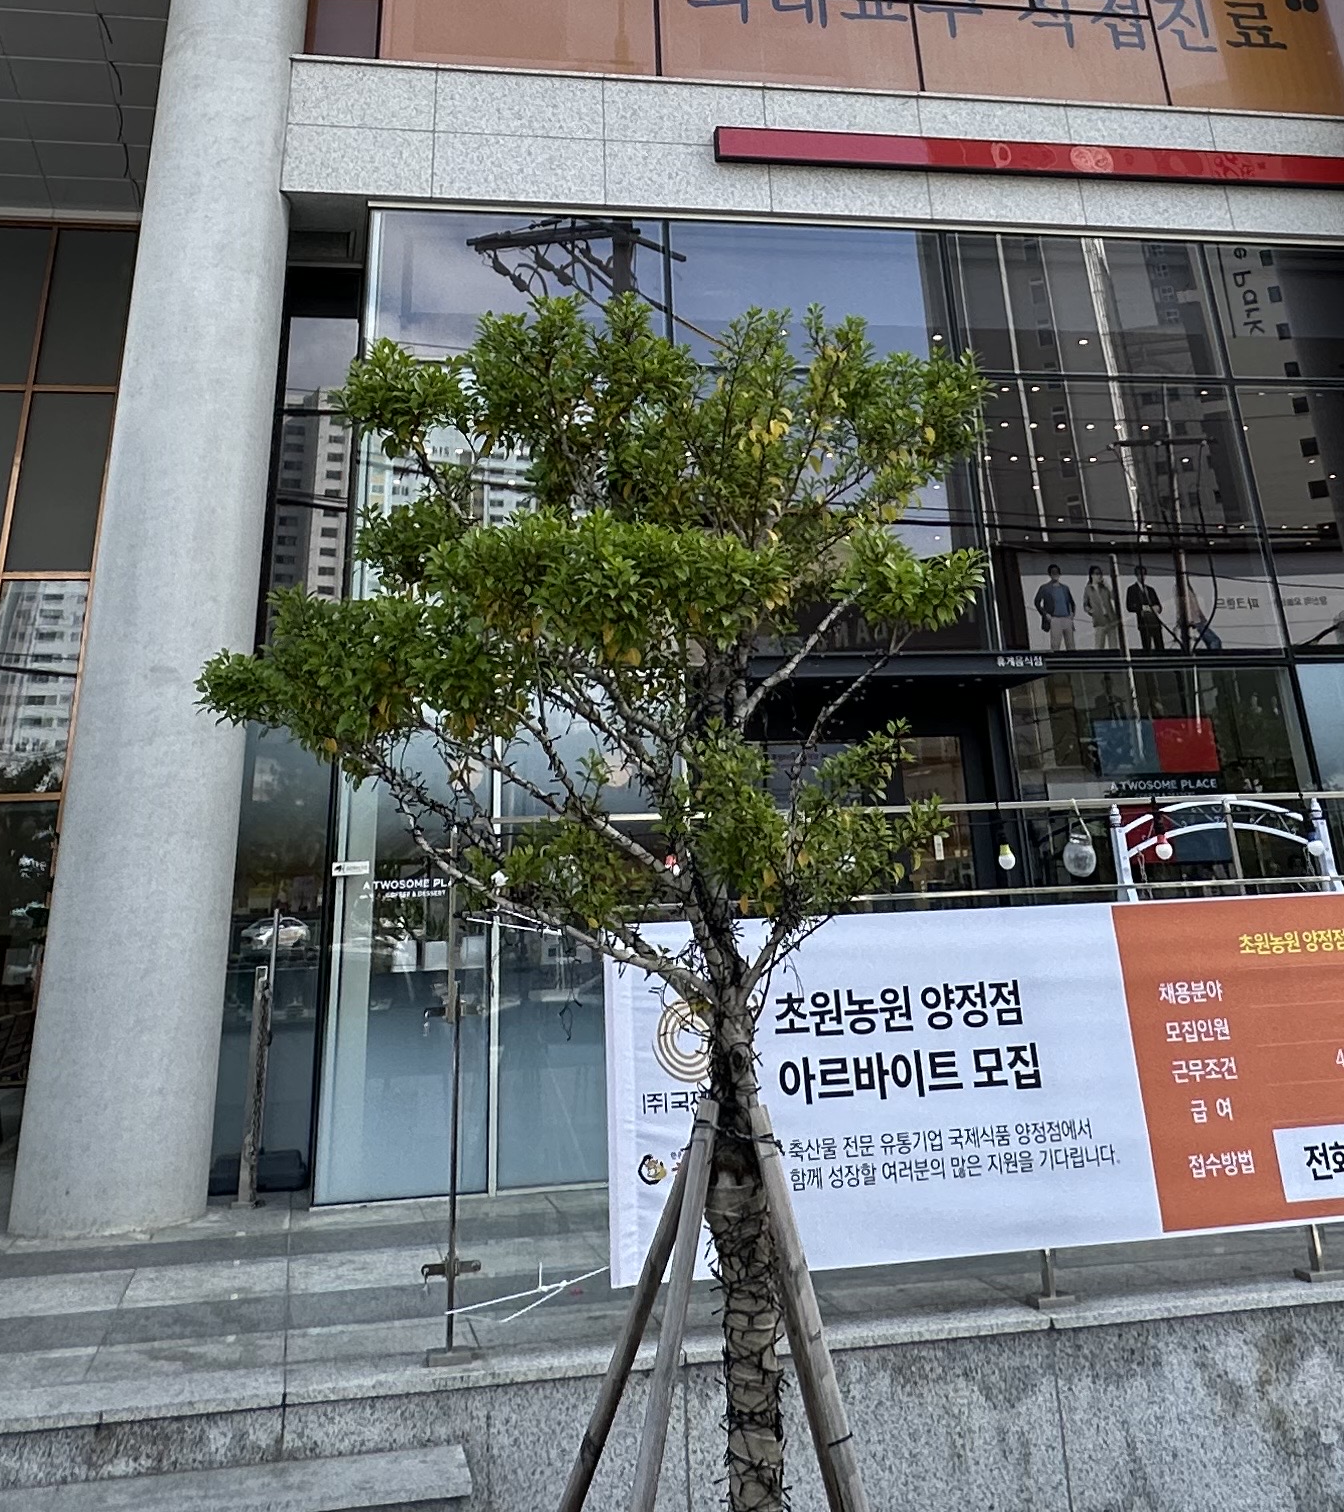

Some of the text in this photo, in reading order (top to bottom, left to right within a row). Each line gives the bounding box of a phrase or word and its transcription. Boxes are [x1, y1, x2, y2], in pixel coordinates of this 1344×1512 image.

[1120, 779, 1177, 791] TWOSOME
[1181, 778, 1217, 789] PLACE
[373, 879, 430, 890] TWOSOME
[1239, 931, 1301, 955] 초원농원
[1158, 980, 1224, 1005] 채용분야
[774, 979, 1024, 1037] 초원농원 양정점
[1165, 1018, 1231, 1044] 모집인원
[778, 1041, 1042, 1106] 아르바이트 모집
[1172, 1058, 1238, 1084] 근무조건
[788, 1118, 1093, 1162] 축산물 전문 유통기업 국제식품 양정점에서
[789, 1165, 823, 1191] 함께
[828, 1163, 876, 1190] 성장할
[881, 1157, 946, 1184] 여러분의
[950, 1153, 982, 1179] 많은
[986, 1149, 1034, 1176] 지원을
[1188, 1151, 1256, 1179] 접수방법
